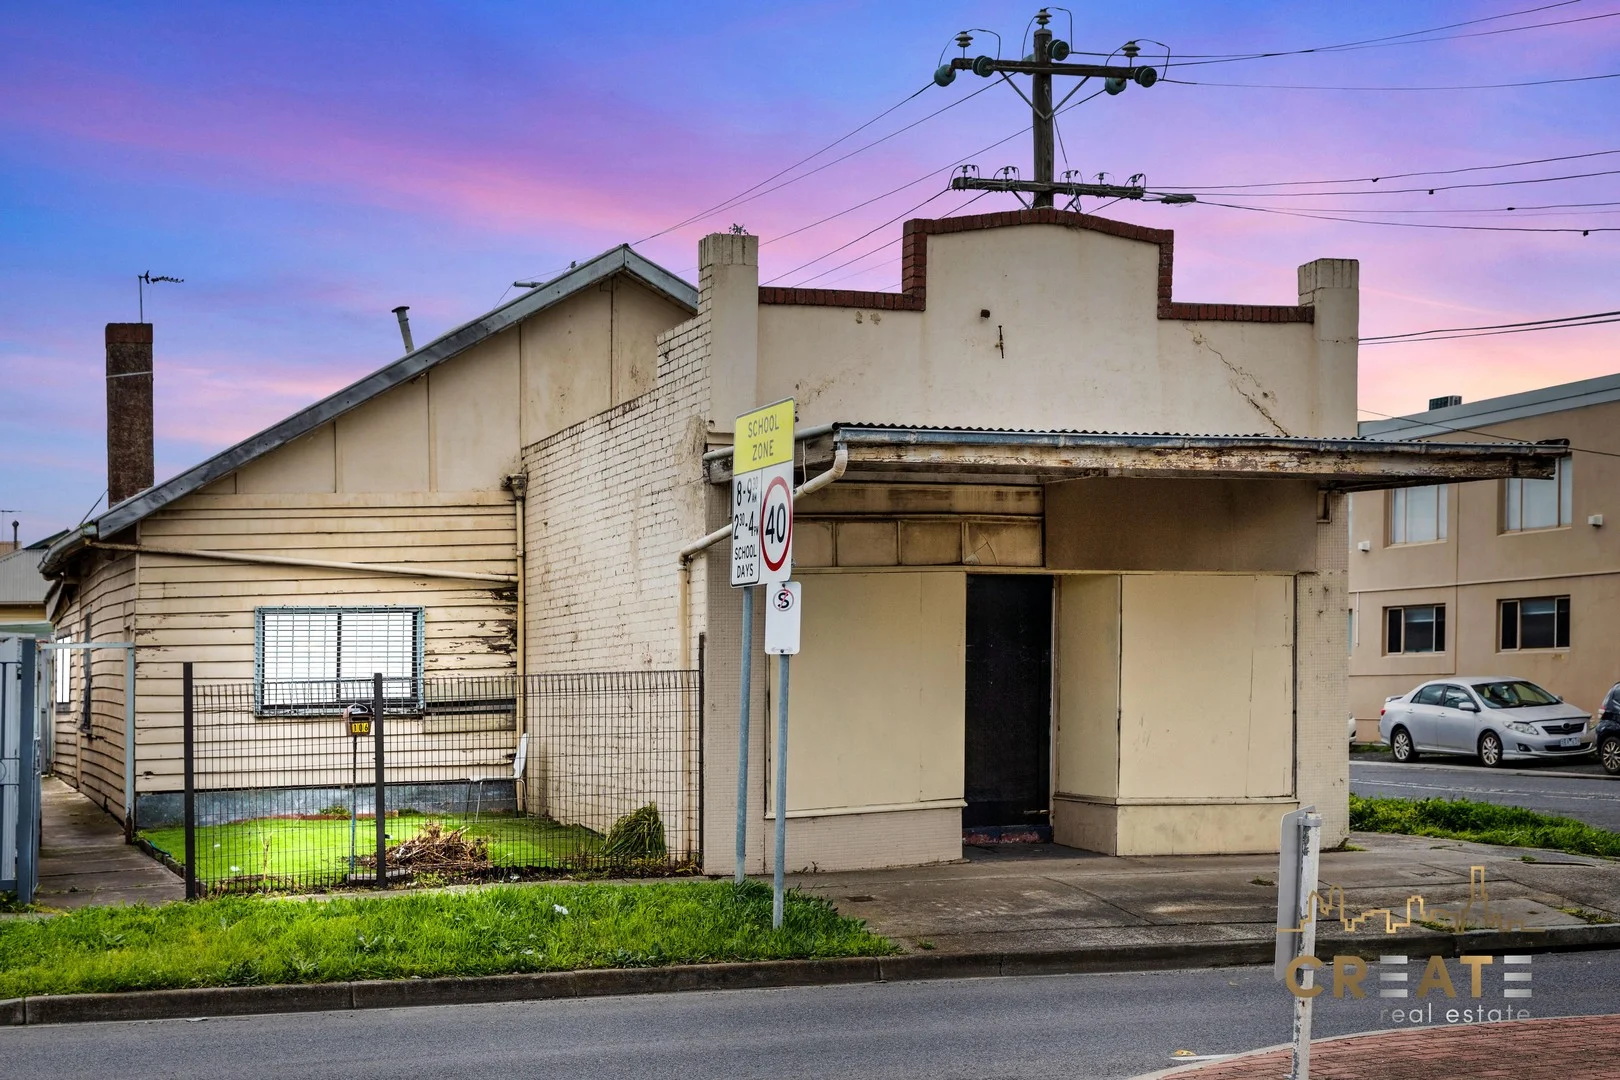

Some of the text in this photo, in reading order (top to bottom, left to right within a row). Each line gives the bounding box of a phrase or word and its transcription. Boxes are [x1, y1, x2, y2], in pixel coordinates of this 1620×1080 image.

[748, 414, 779, 438] SCHOOL
[752, 439, 774, 461] ZONE
[765, 502, 786, 544] 40
[734, 544, 757, 560] SCHOOL
[737, 563, 754, 578] DAYS
[353, 723, 369, 732] 106
